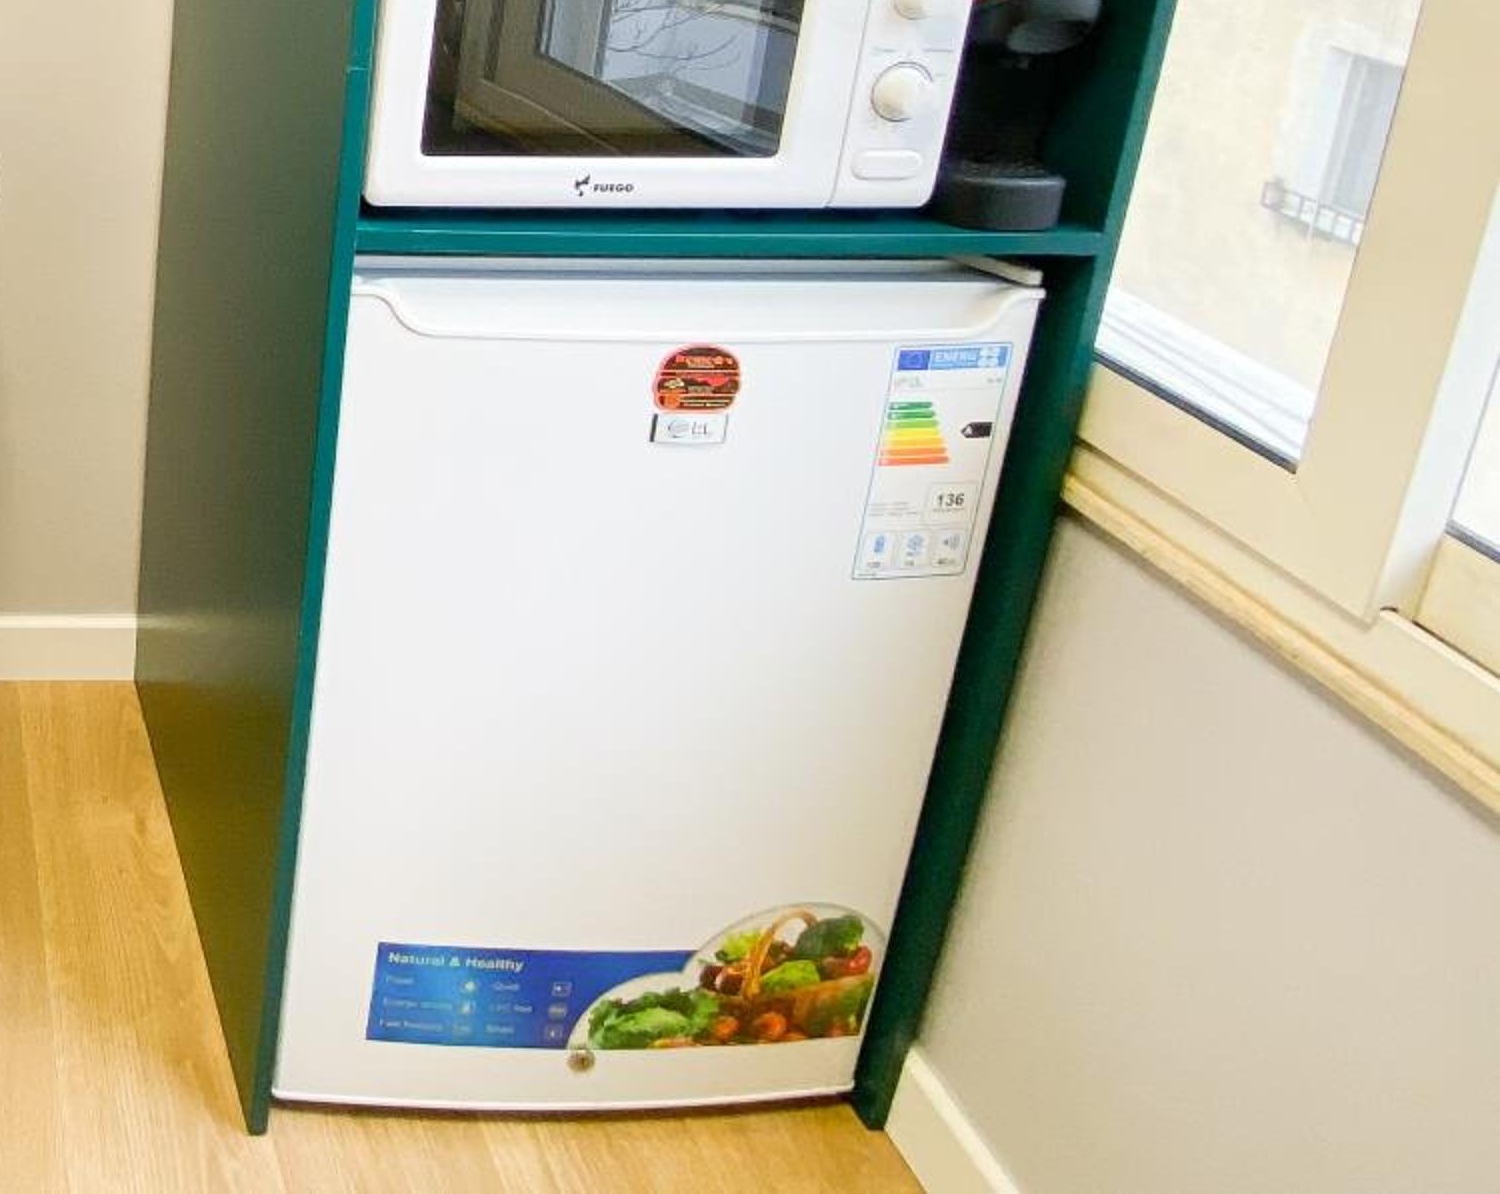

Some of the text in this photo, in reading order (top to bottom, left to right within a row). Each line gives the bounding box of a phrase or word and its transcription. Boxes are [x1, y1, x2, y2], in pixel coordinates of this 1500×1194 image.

[593, 183, 635, 193] FUEGO
[937, 492, 965, 507] 136
[387, 951, 524, 973] Natural & Healthy
